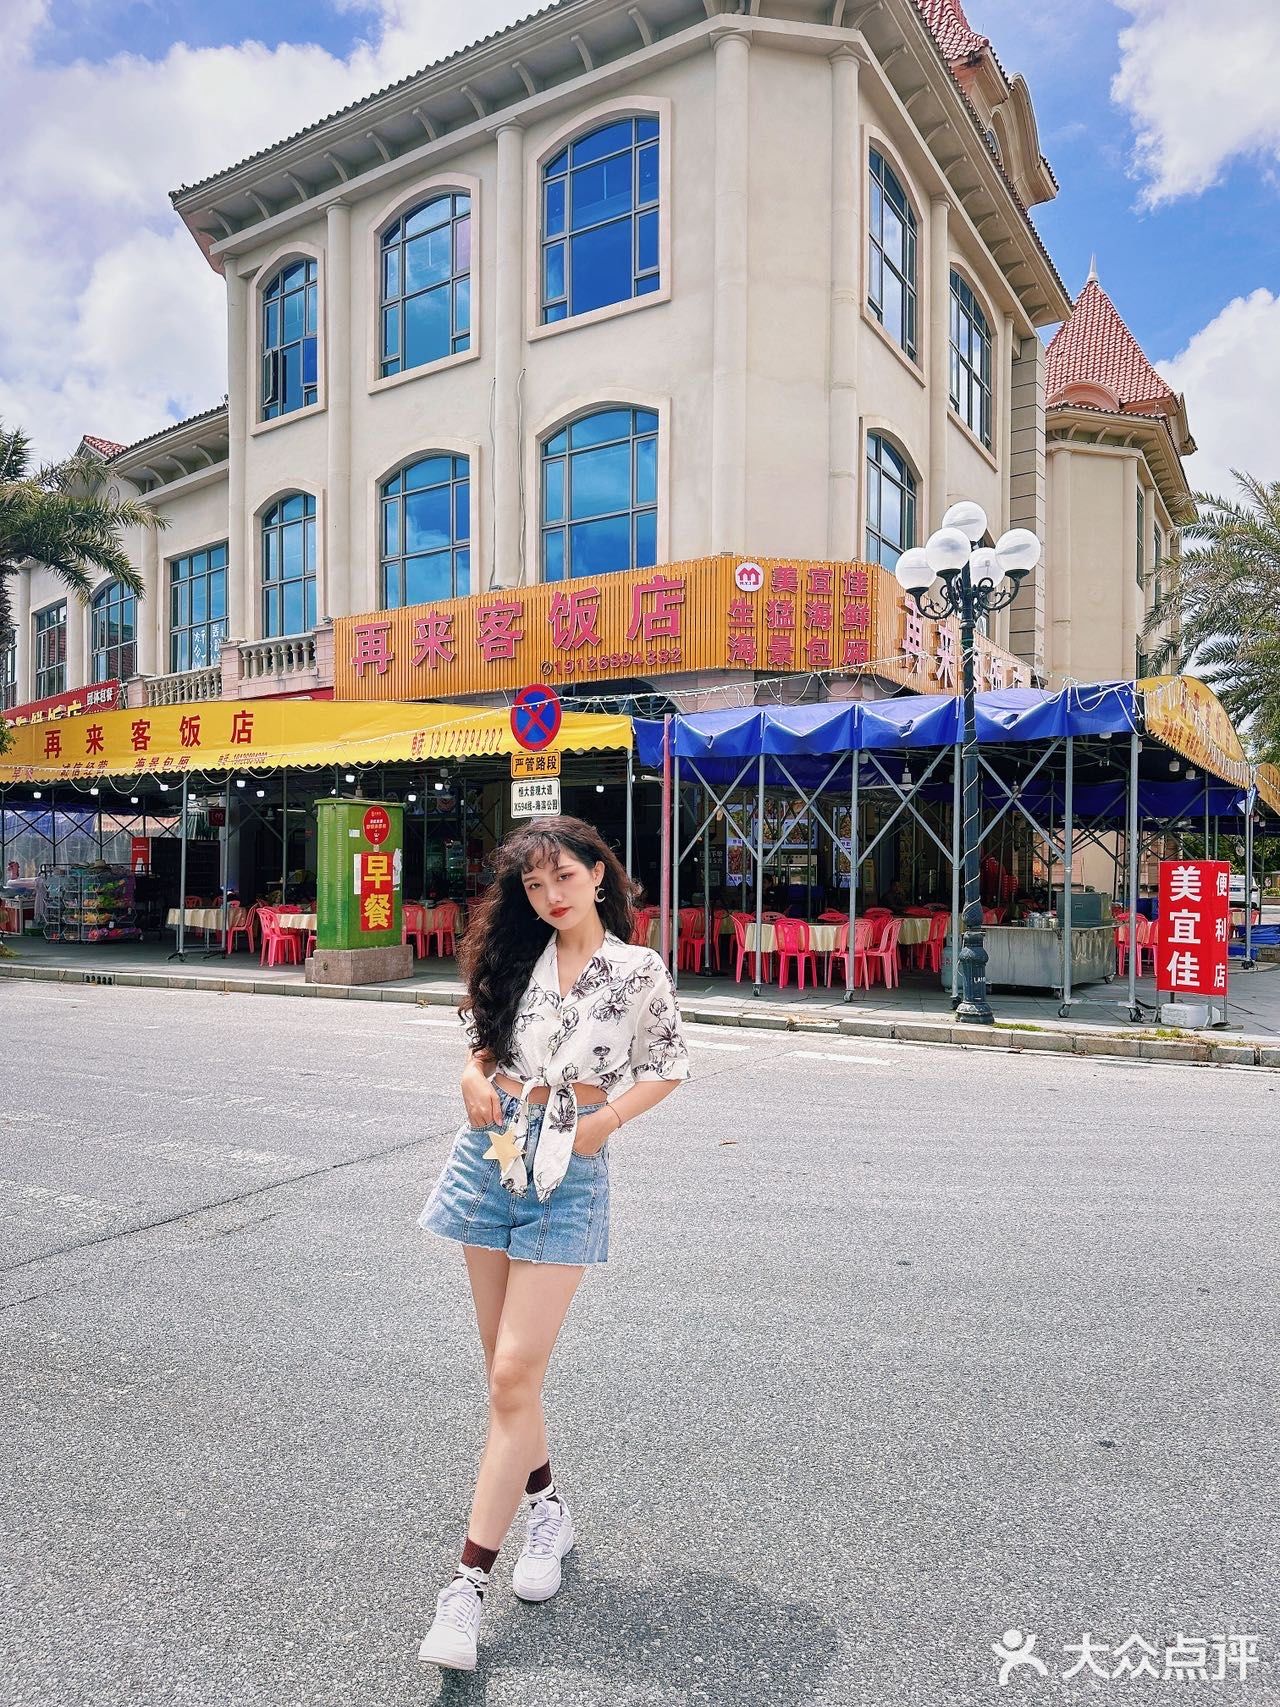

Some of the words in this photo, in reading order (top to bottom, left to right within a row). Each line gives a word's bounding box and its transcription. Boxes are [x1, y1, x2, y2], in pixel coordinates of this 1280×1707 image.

[772, 565, 869, 598] 美宜佳
[351, 574, 685, 677] 再来客饭店
[727, 597, 871, 633] 生猛海鲜
[555, 647, 682, 675] 19126894382
[727, 633, 870, 667] 海景包厢
[44, 709, 254, 759] 再来客饭店
[515, 755, 557, 772] 严管路段
[364, 855, 392, 929] 早餐
[1166, 865, 1203, 988] 美宜佳
[1214, 871, 1229, 989] 便利店
